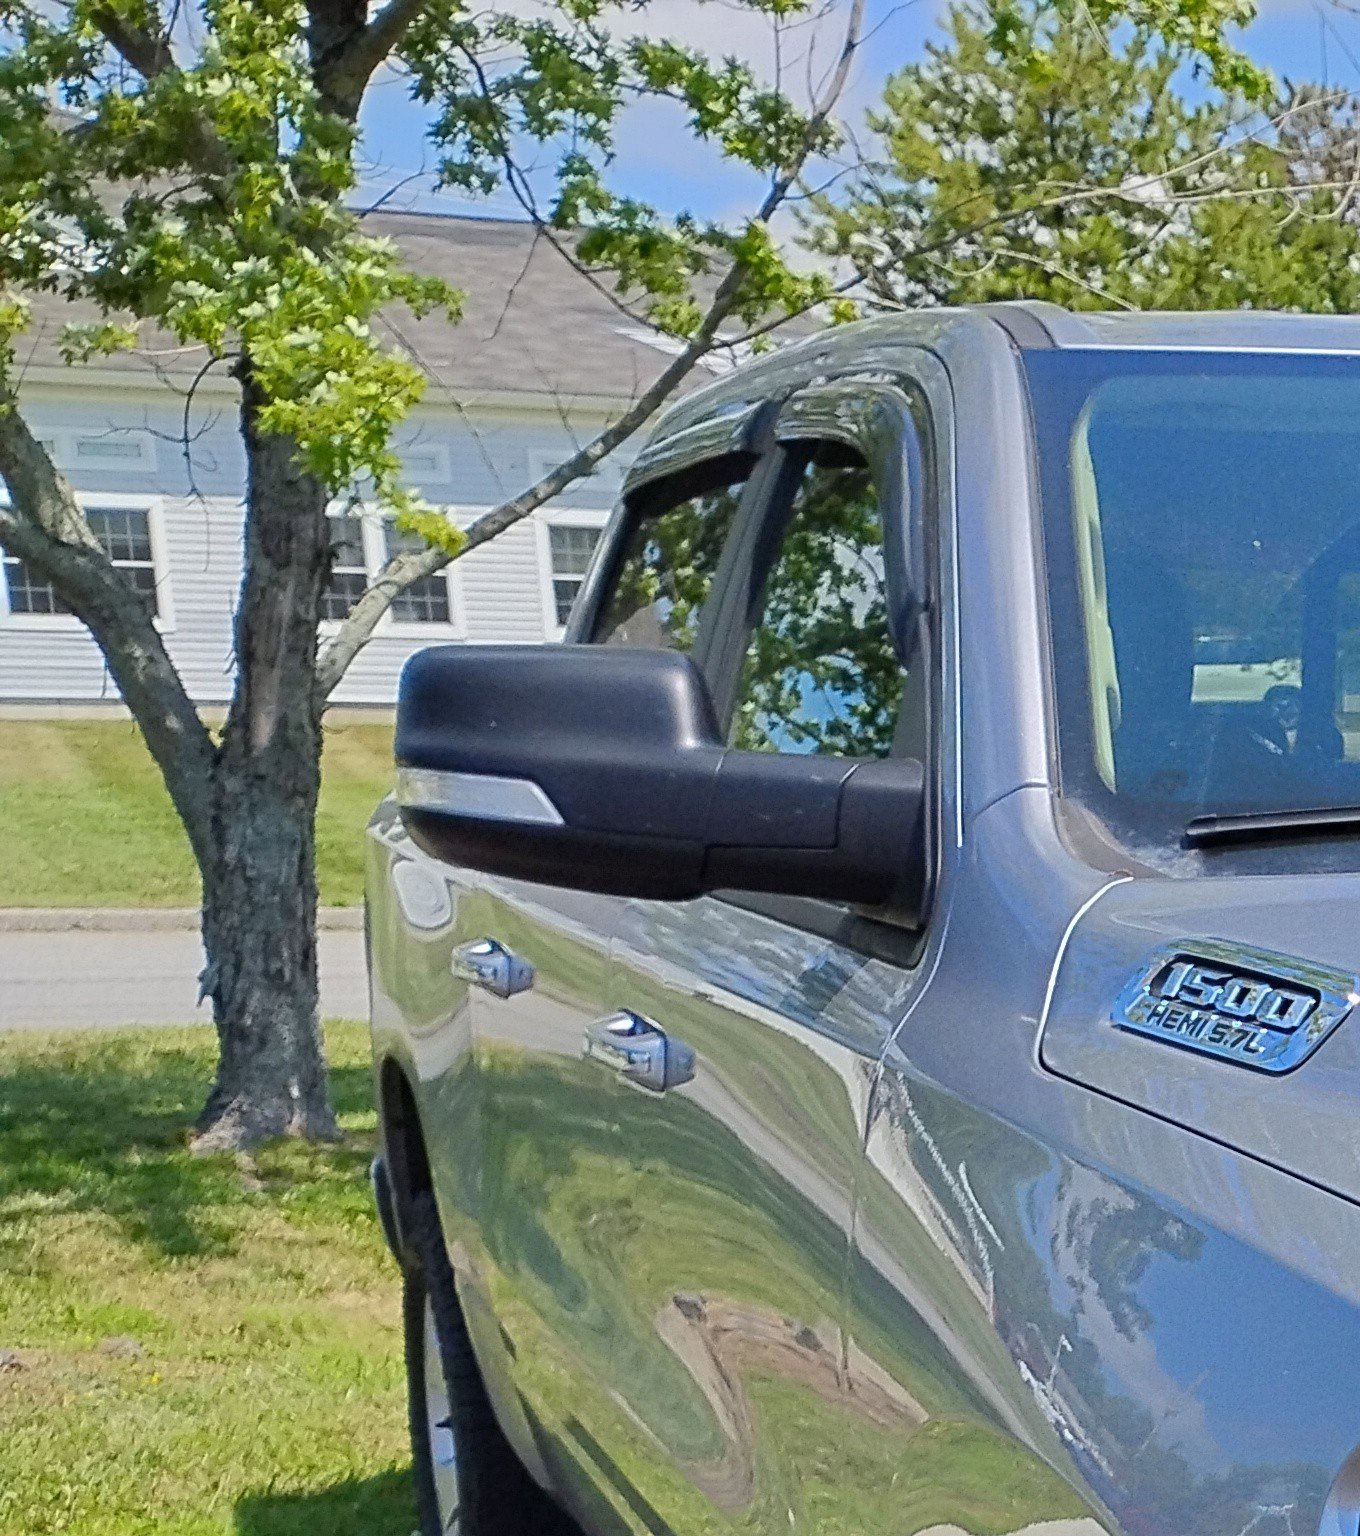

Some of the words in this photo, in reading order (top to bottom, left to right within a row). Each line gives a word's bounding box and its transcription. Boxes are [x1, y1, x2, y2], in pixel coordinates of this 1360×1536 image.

[1159, 962, 1317, 1029] 1500
[1146, 1004, 1207, 1039] HEMI
[1211, 1021, 1263, 1055] 5.7L
